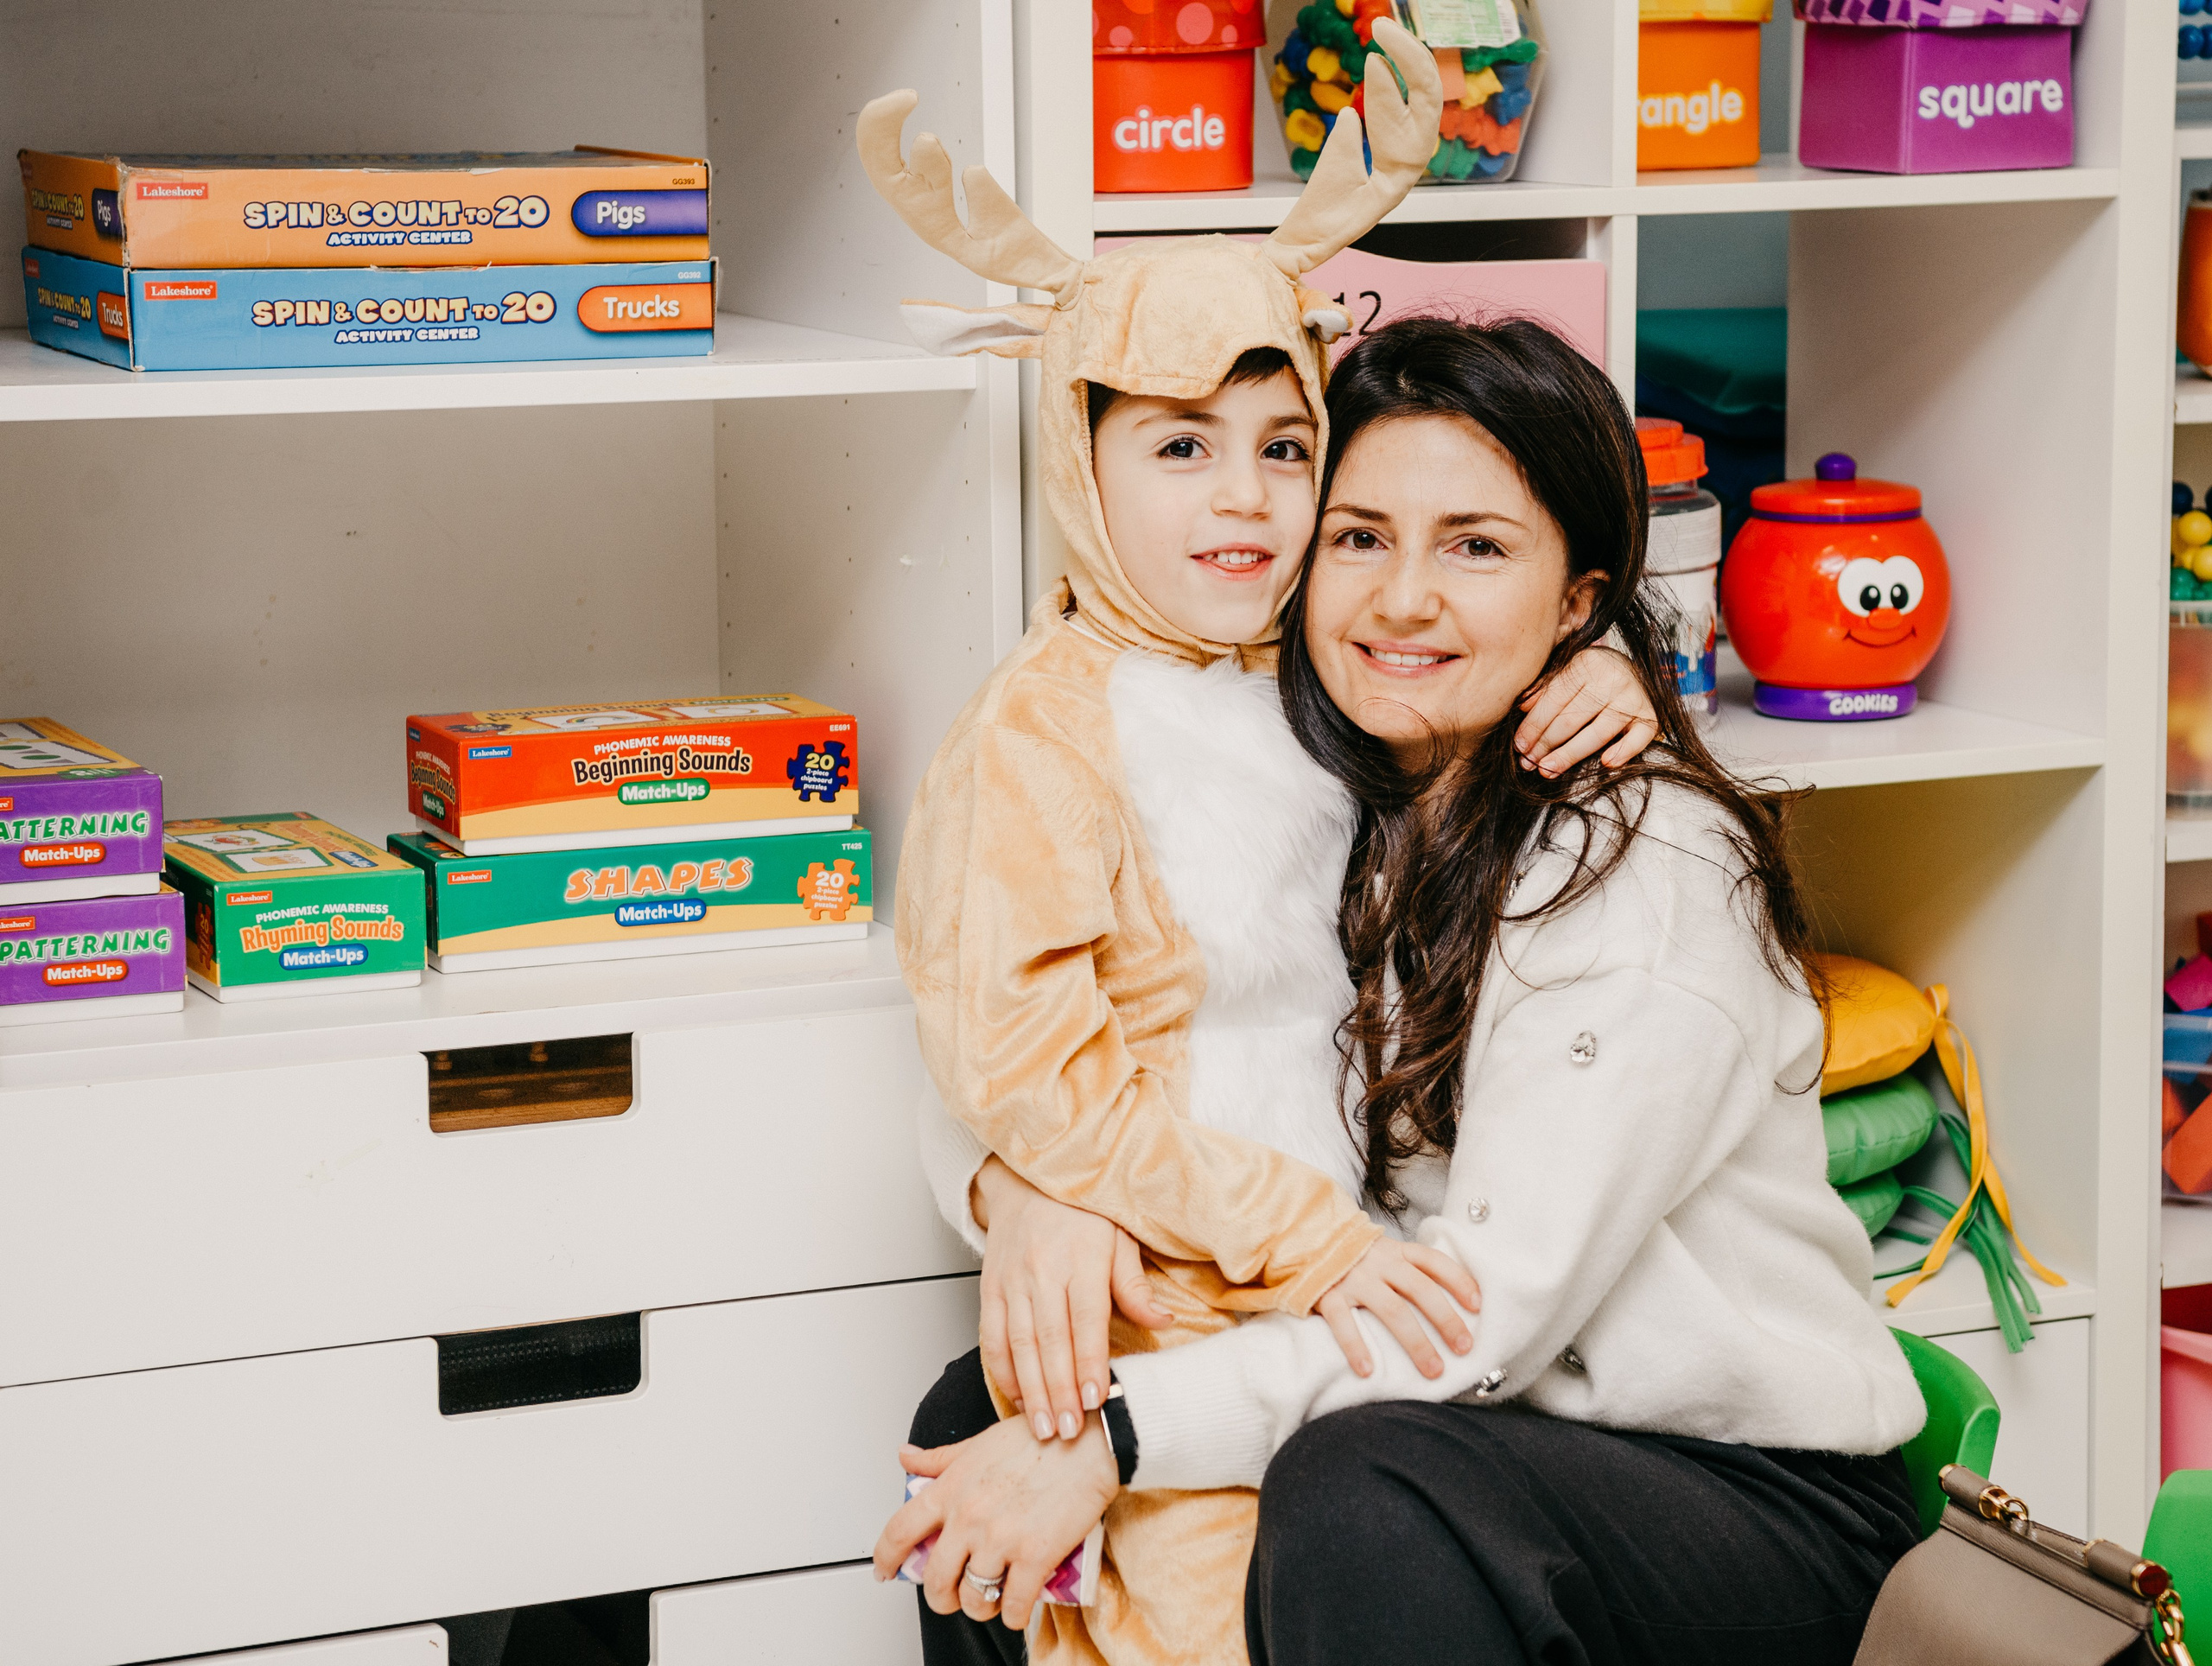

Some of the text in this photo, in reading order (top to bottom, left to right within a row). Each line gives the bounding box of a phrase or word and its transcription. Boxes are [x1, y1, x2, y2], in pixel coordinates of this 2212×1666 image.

[1637, 82, 1744, 134] angle
[1917, 79, 2064, 129] square
[1114, 106, 1225, 149] circle
[142, 186, 204, 198] Lakeshore
[73, 194, 84, 220] 20
[97, 200, 111, 226] Pigs
[244, 195, 550, 229] SPIN & COUNT TO 20
[596, 200, 646, 230] Pigs
[327, 230, 473, 246] ACTIVITY CENTER
[150, 285, 213, 296] Lakeshore
[54, 292, 75, 314] COUNT
[79, 296, 92, 321] 20
[102, 302, 124, 327] Trucks
[251, 291, 556, 327] SPIN & COUNT TO 20
[603, 294, 680, 319] Trucks
[334, 327, 480, 344] ACTIVITY CENTER
[472, 747, 510, 758] Lakeshore
[594, 734, 732, 755] PHONEMIC AWARENESS
[572, 746, 753, 785] Beginning Sounds
[804, 753, 835, 771] 20
[800, 775, 833, 785] chipboard
[806, 768, 830, 777] 2-piece
[622, 782, 706, 801] Match-Ups
[803, 783, 828, 792] puzzles
[0, 811, 149, 844] ATTERNING
[24, 846, 101, 862] Match-Ups
[451, 872, 489, 882] Lakeshore
[564, 857, 753, 902] SHAPES
[815, 871, 845, 889] 20
[231, 893, 270, 904] Lakeshore
[810, 893, 843, 903] chipboard
[256, 903, 390, 924] PHONEMIC AWARENESS
[619, 902, 702, 922] Match-Ups
[0, 920, 32, 929] keshore
[240, 919, 328, 953] Rhyming
[331, 915, 404, 941] Sounds
[0, 928, 171, 965] PATTERNING
[283, 948, 364, 966] Match-Ups
[47, 963, 124, 980] Match-Ups
